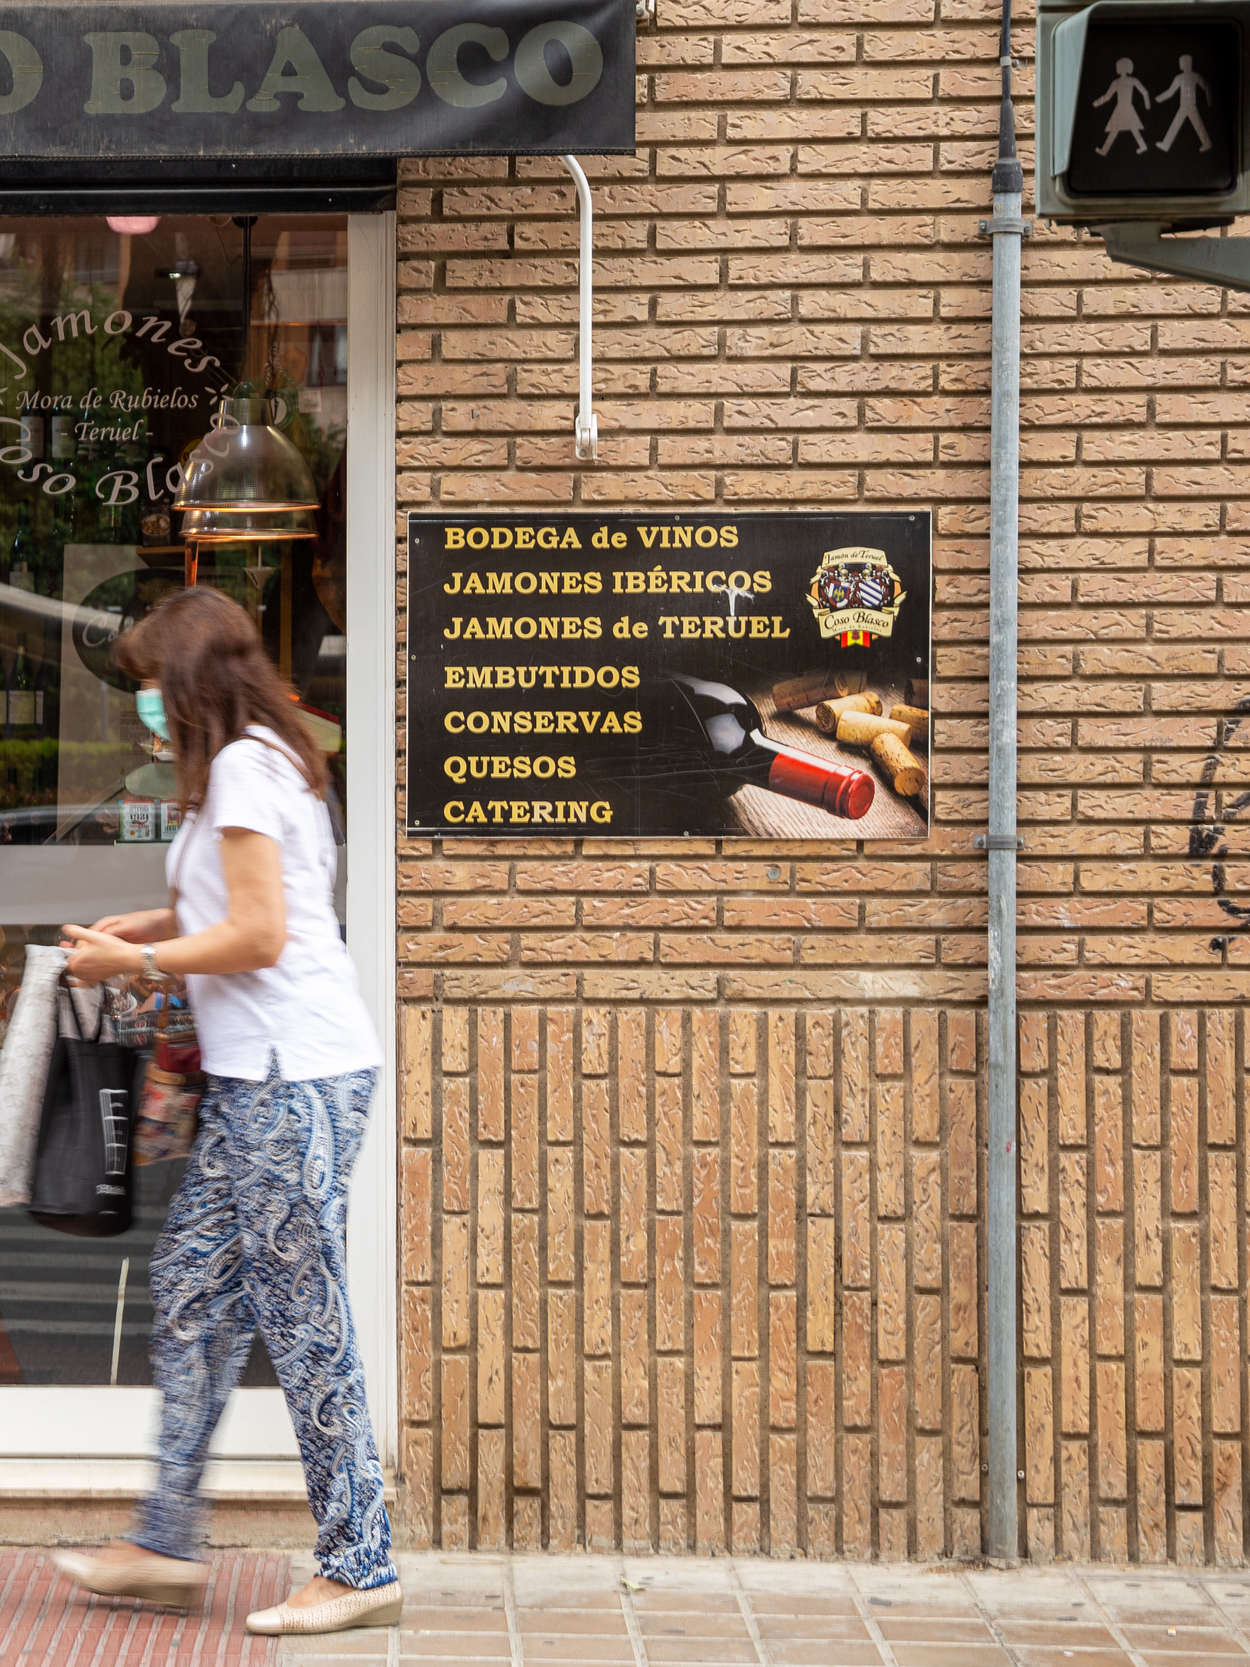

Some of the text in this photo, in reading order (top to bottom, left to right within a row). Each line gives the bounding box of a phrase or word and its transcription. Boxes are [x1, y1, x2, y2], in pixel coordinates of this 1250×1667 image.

[83, 20, 604, 116] BLASCO
[15, 387, 199, 413] Mora de Rubielos
[95, 412, 241, 505] Blasco
[444, 525, 739, 549] BODEGA de VINOS
[824, 554, 849, 565] Jamón
[858, 550, 884, 561] Teruel
[444, 565, 772, 595] JAMONES IBÉRICOS
[444, 616, 791, 640] JAMONES de TERUEL
[824, 610, 890, 630] Coso Blasco
[444, 667, 641, 688] EMBUTIDOS
[444, 711, 643, 734] CONSERVAS
[444, 756, 577, 784] QUESOS
[444, 801, 613, 824] CATERING
